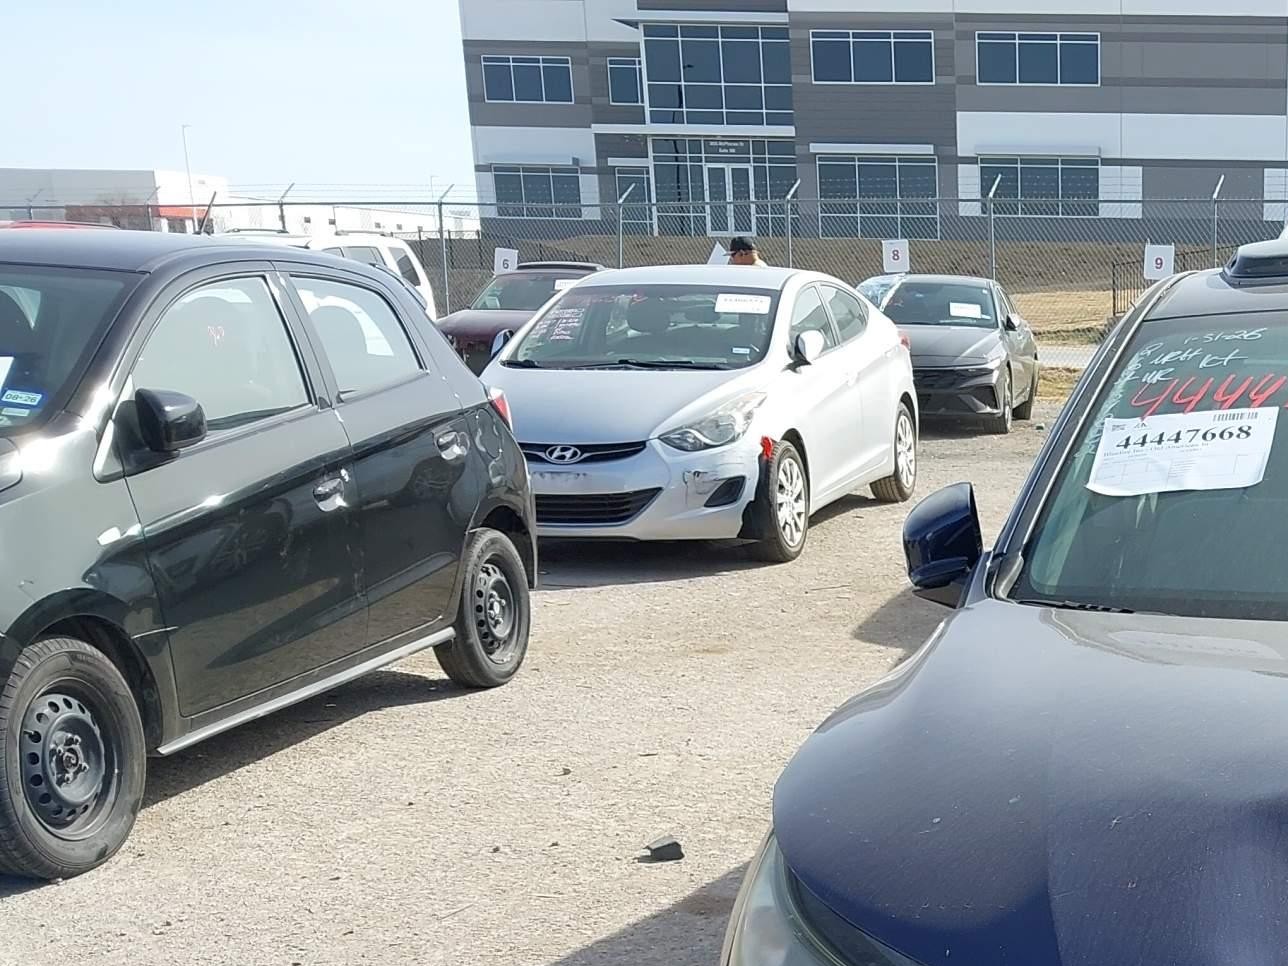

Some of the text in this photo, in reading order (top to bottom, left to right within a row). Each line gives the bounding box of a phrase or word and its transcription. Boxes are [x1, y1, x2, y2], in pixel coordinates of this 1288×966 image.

[892, 249, 900, 261] 8
[502, 258, 510, 270] 6
[1154, 257, 1164, 270] 9
[1115, 424, 1252, 450] 44447668
